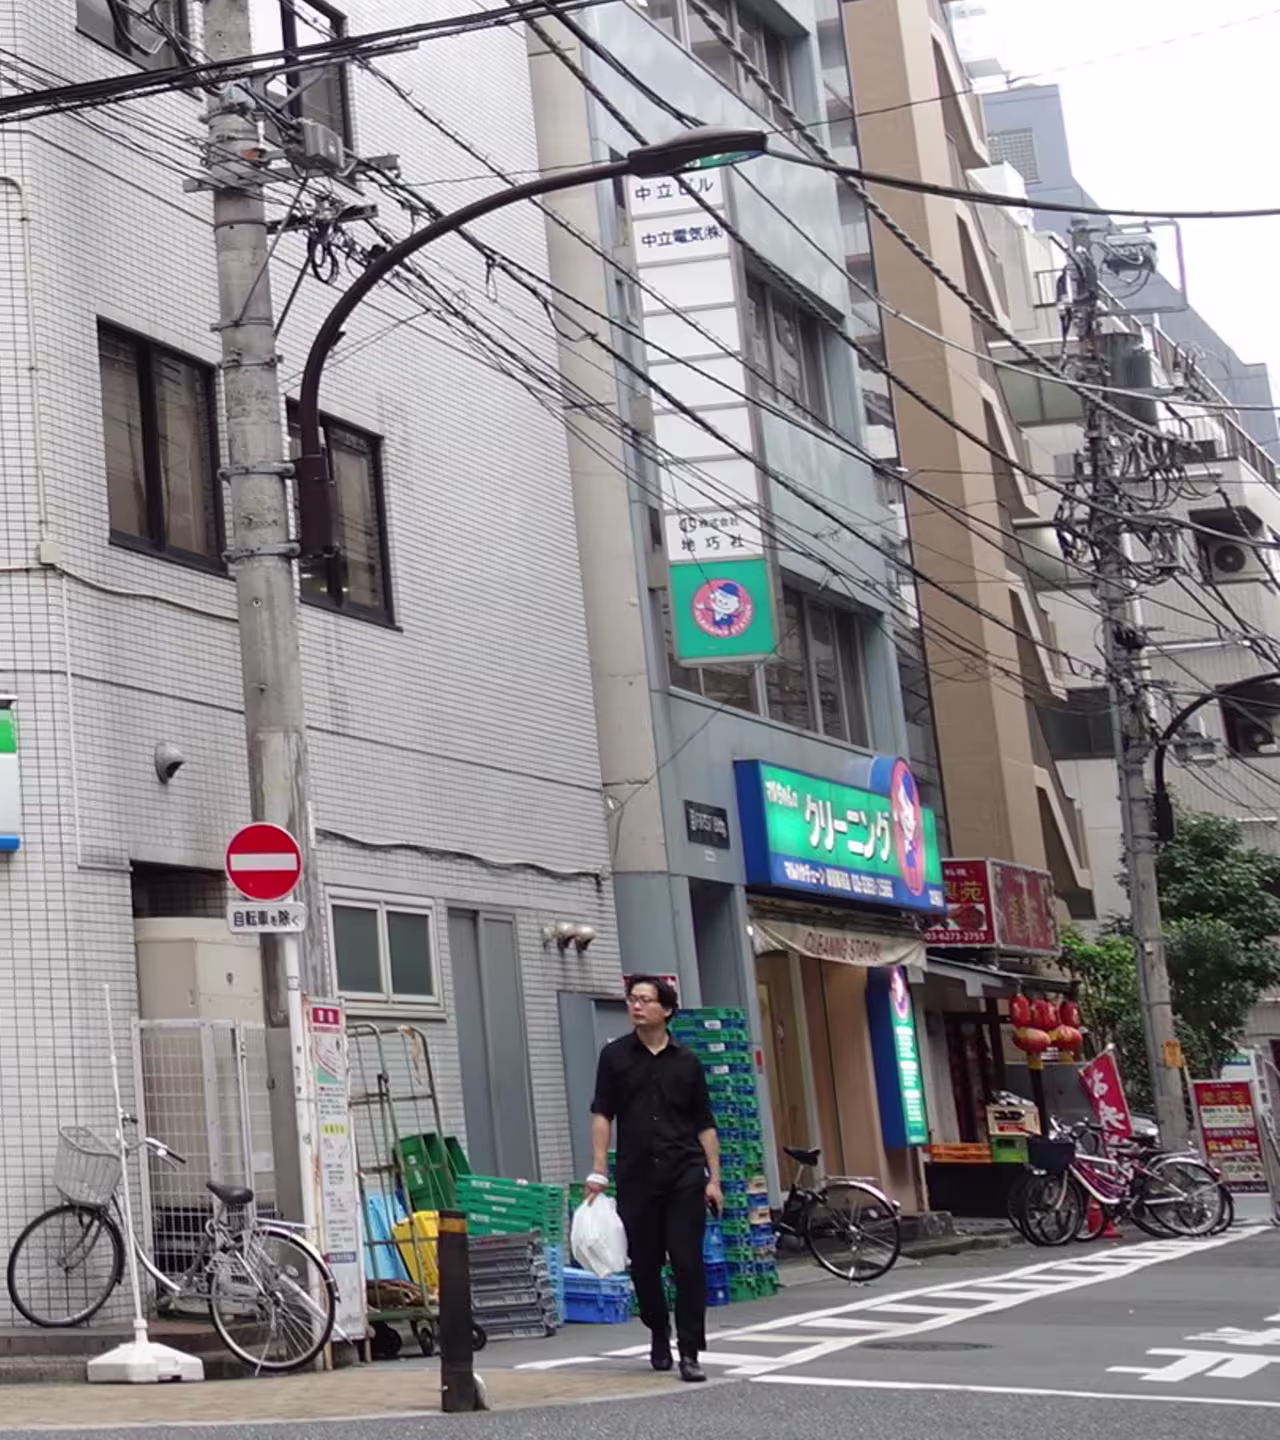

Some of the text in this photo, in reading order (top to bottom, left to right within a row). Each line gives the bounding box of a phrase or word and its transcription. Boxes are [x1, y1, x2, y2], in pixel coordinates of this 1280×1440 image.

[805, 794, 891, 861] クリーニング
[233, 910, 300, 927] 自転車を除く
